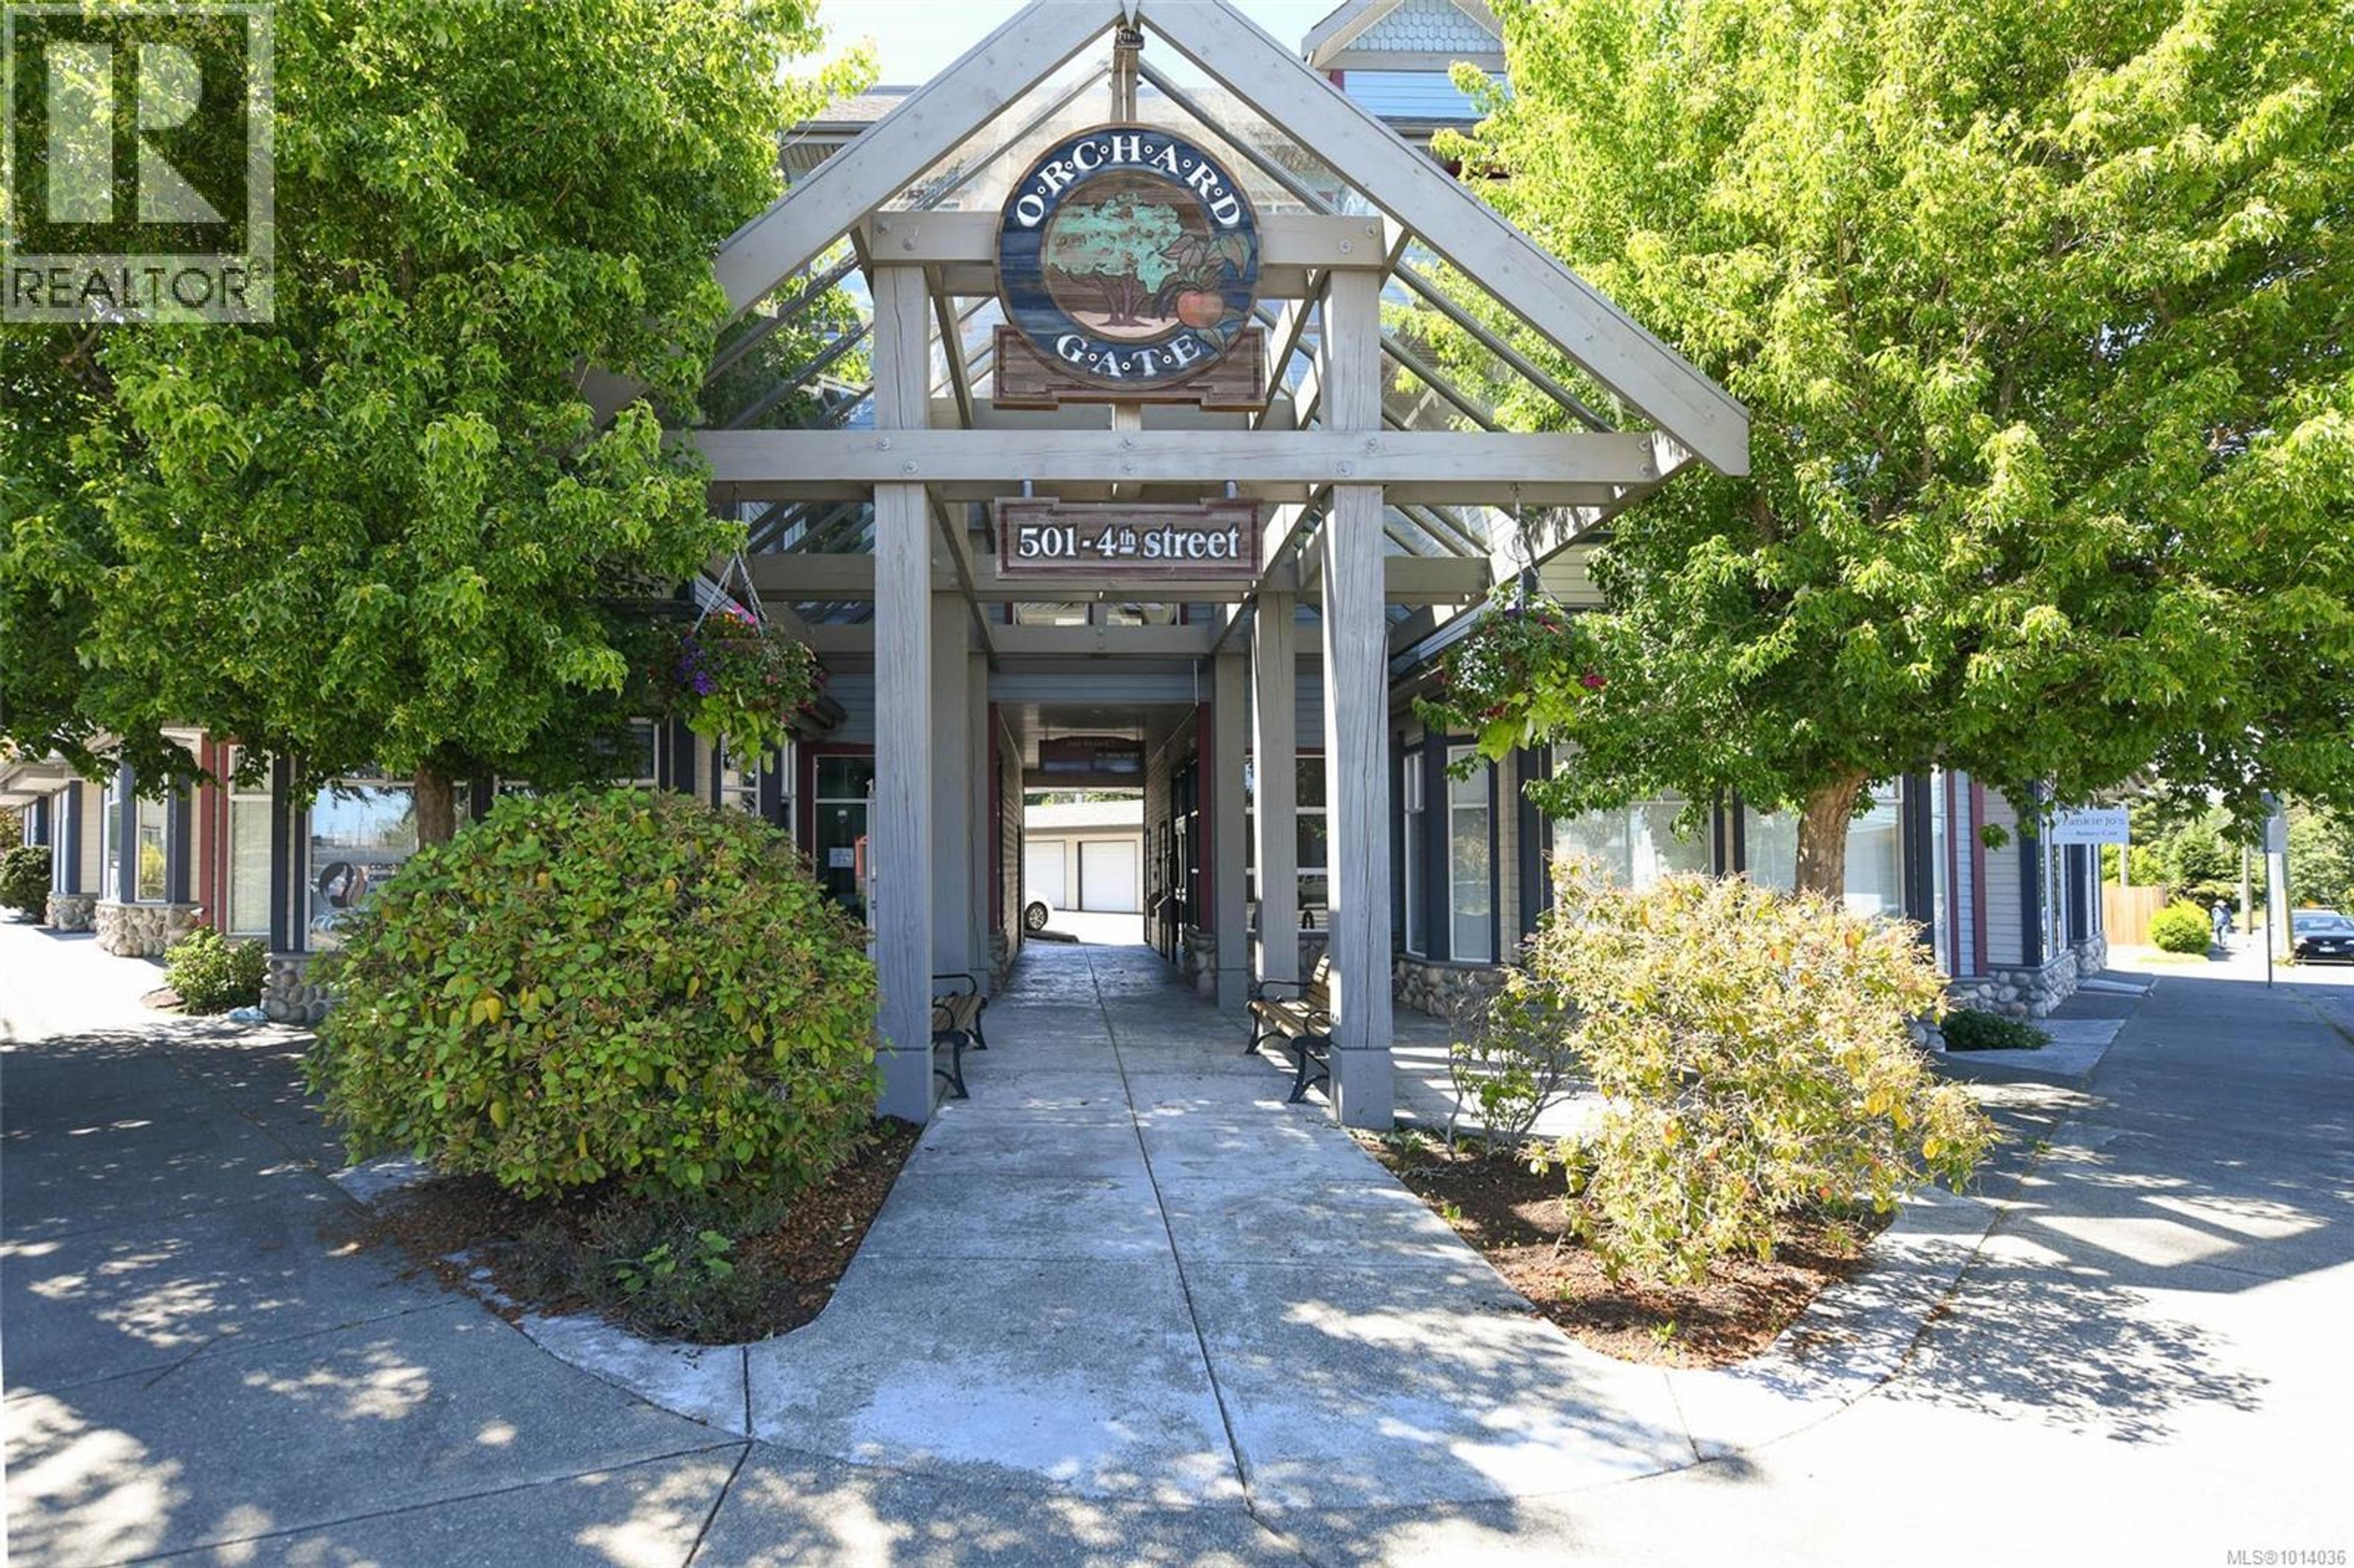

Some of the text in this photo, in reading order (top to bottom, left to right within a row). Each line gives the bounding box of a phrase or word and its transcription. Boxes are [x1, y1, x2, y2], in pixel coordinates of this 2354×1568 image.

[1016, 135, 1241, 228] ORCHARD
[1056, 334, 1202, 378] GATE
[1143, 527, 1240, 558] street
